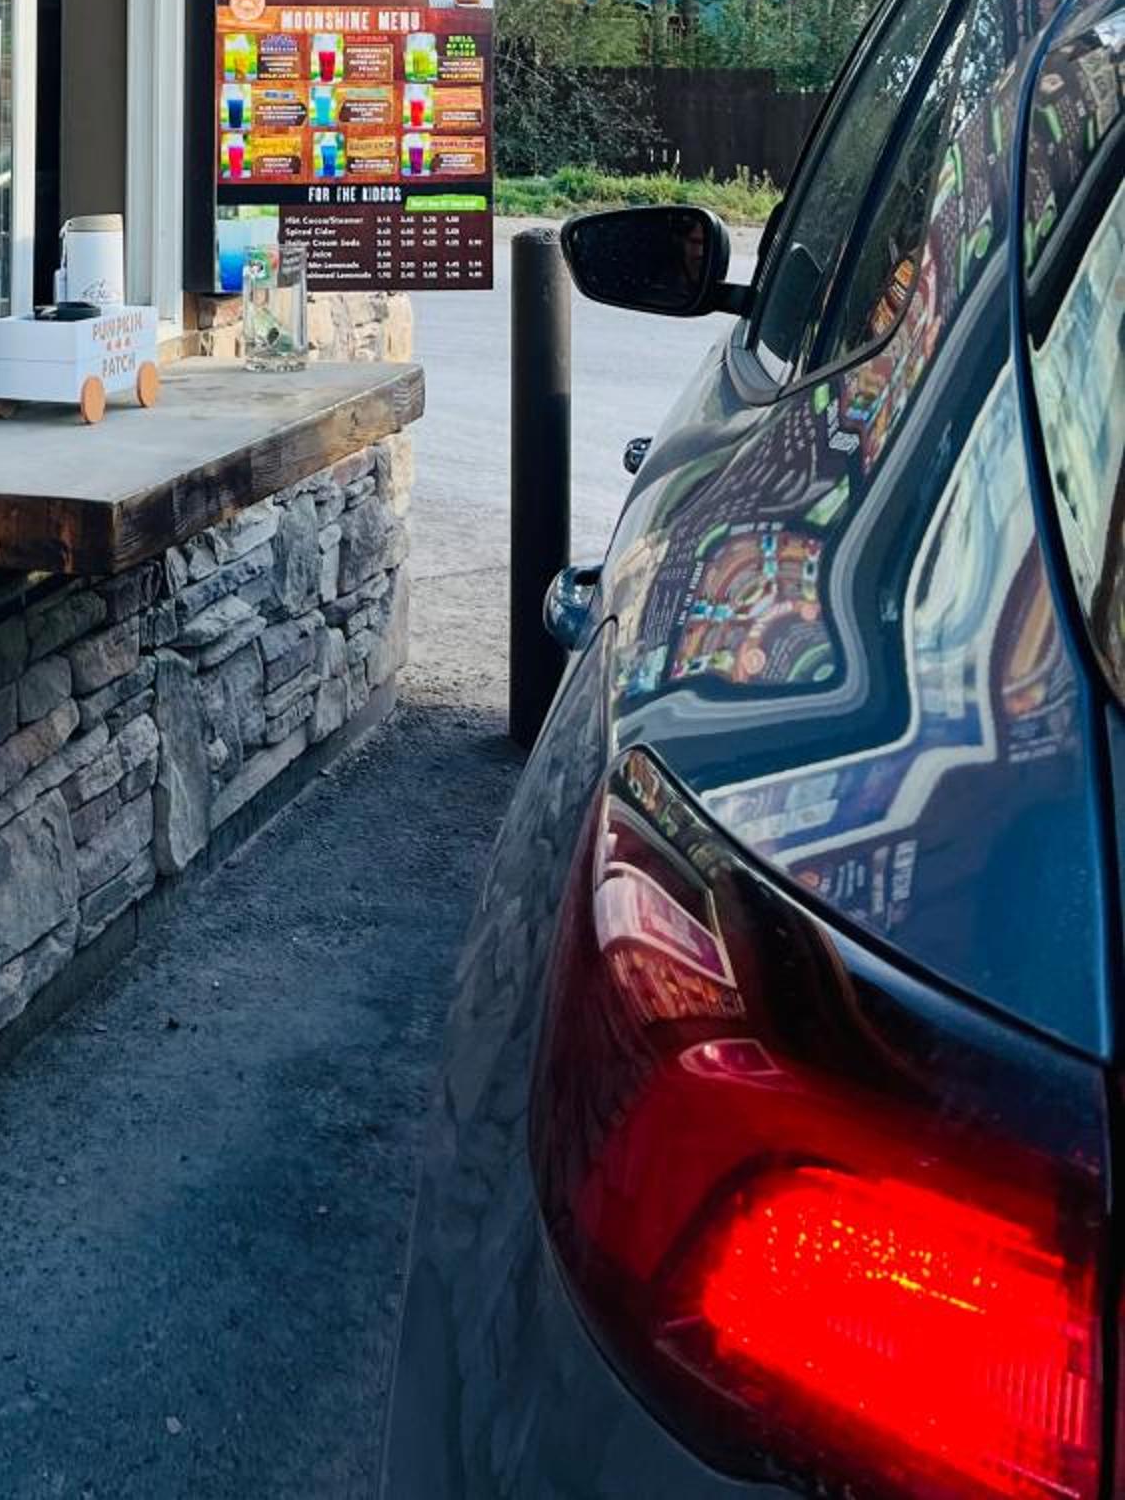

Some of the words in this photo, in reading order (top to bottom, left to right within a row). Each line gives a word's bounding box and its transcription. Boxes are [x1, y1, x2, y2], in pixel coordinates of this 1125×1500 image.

[281, 10, 370, 31] MOONSHINE
[378, 10, 421, 31] MENU
[308, 186, 330, 202] FOR
[336, 186, 357, 202] THE
[362, 186, 402, 202] KIDDOS
[91, 310, 143, 341] PUMPKIN
[101, 354, 137, 378] PATCH
